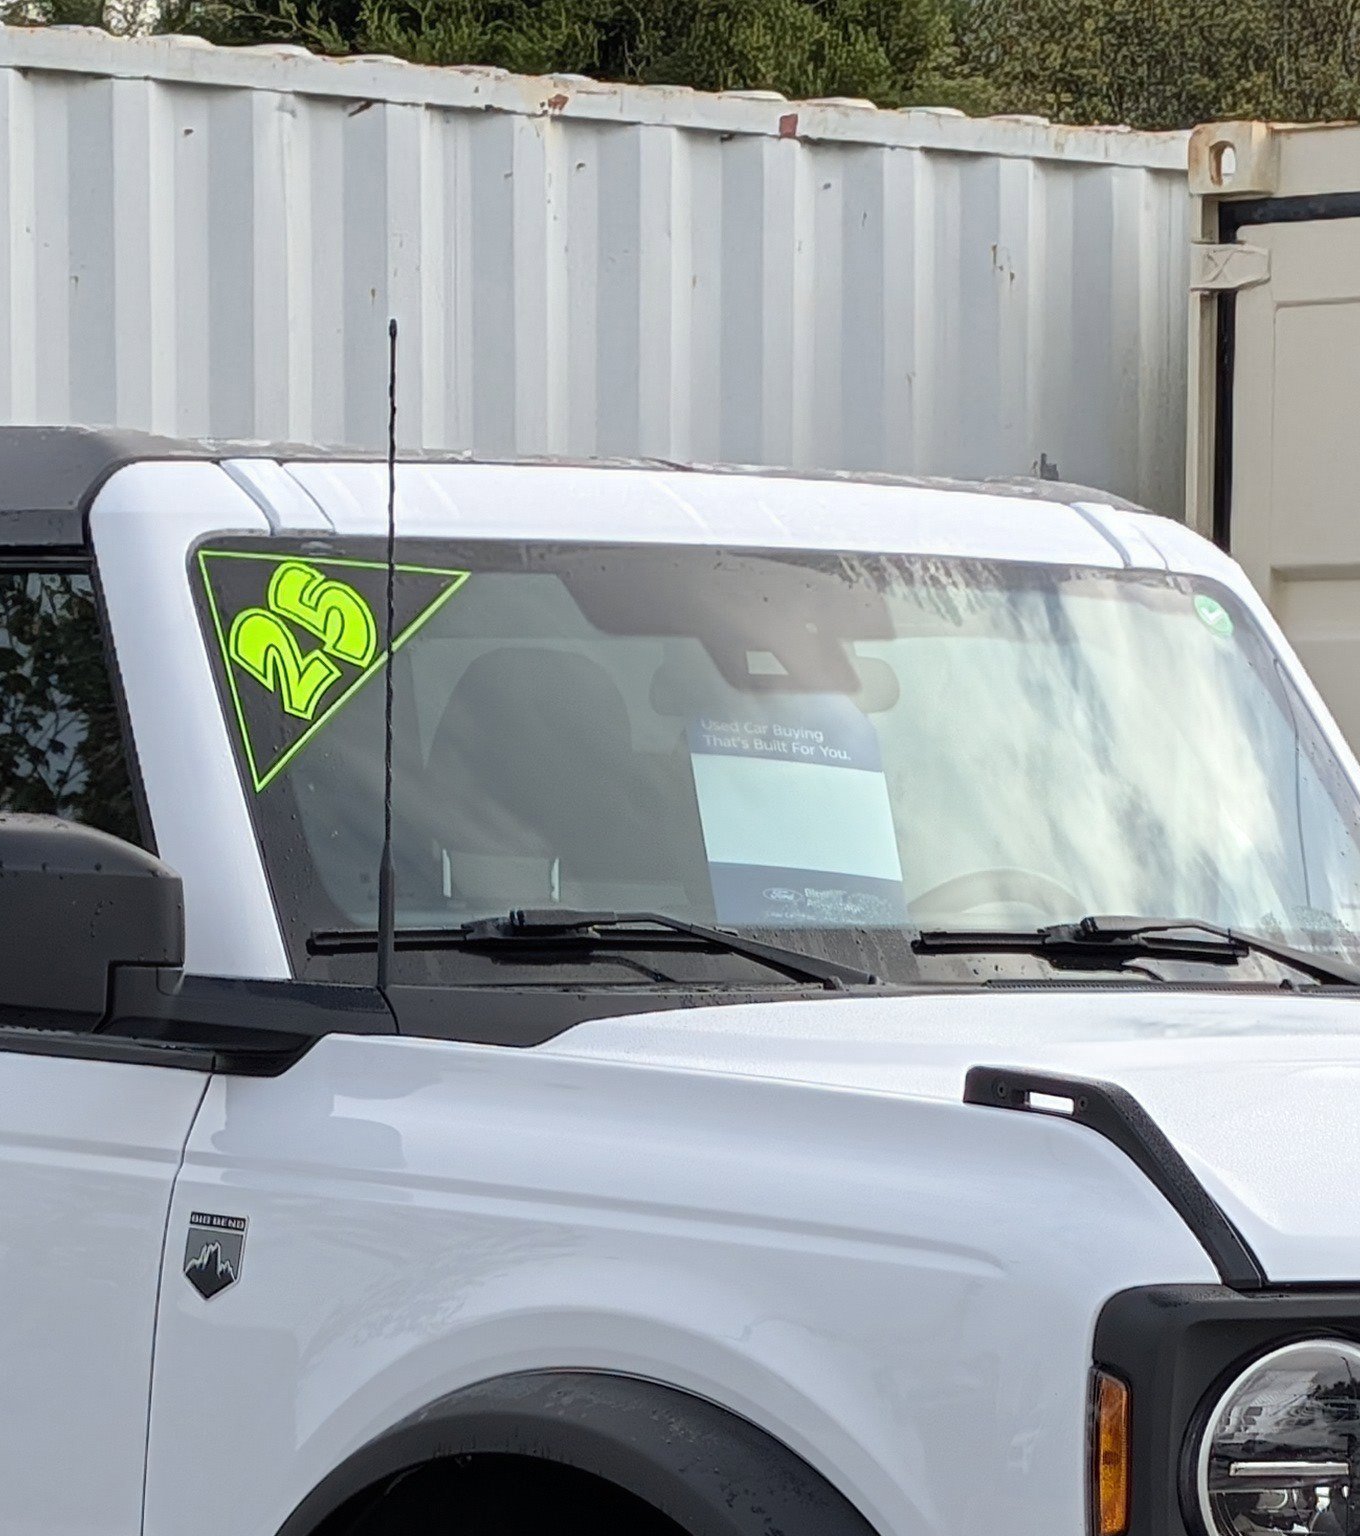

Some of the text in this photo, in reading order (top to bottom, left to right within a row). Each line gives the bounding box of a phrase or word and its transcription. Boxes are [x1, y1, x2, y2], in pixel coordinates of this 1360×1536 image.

[229, 562, 378, 720] 25
[701, 717, 824, 743] Used Car Buying
[703, 734, 852, 761] That's Built For You.
[212, 1216, 245, 1229] BEND
